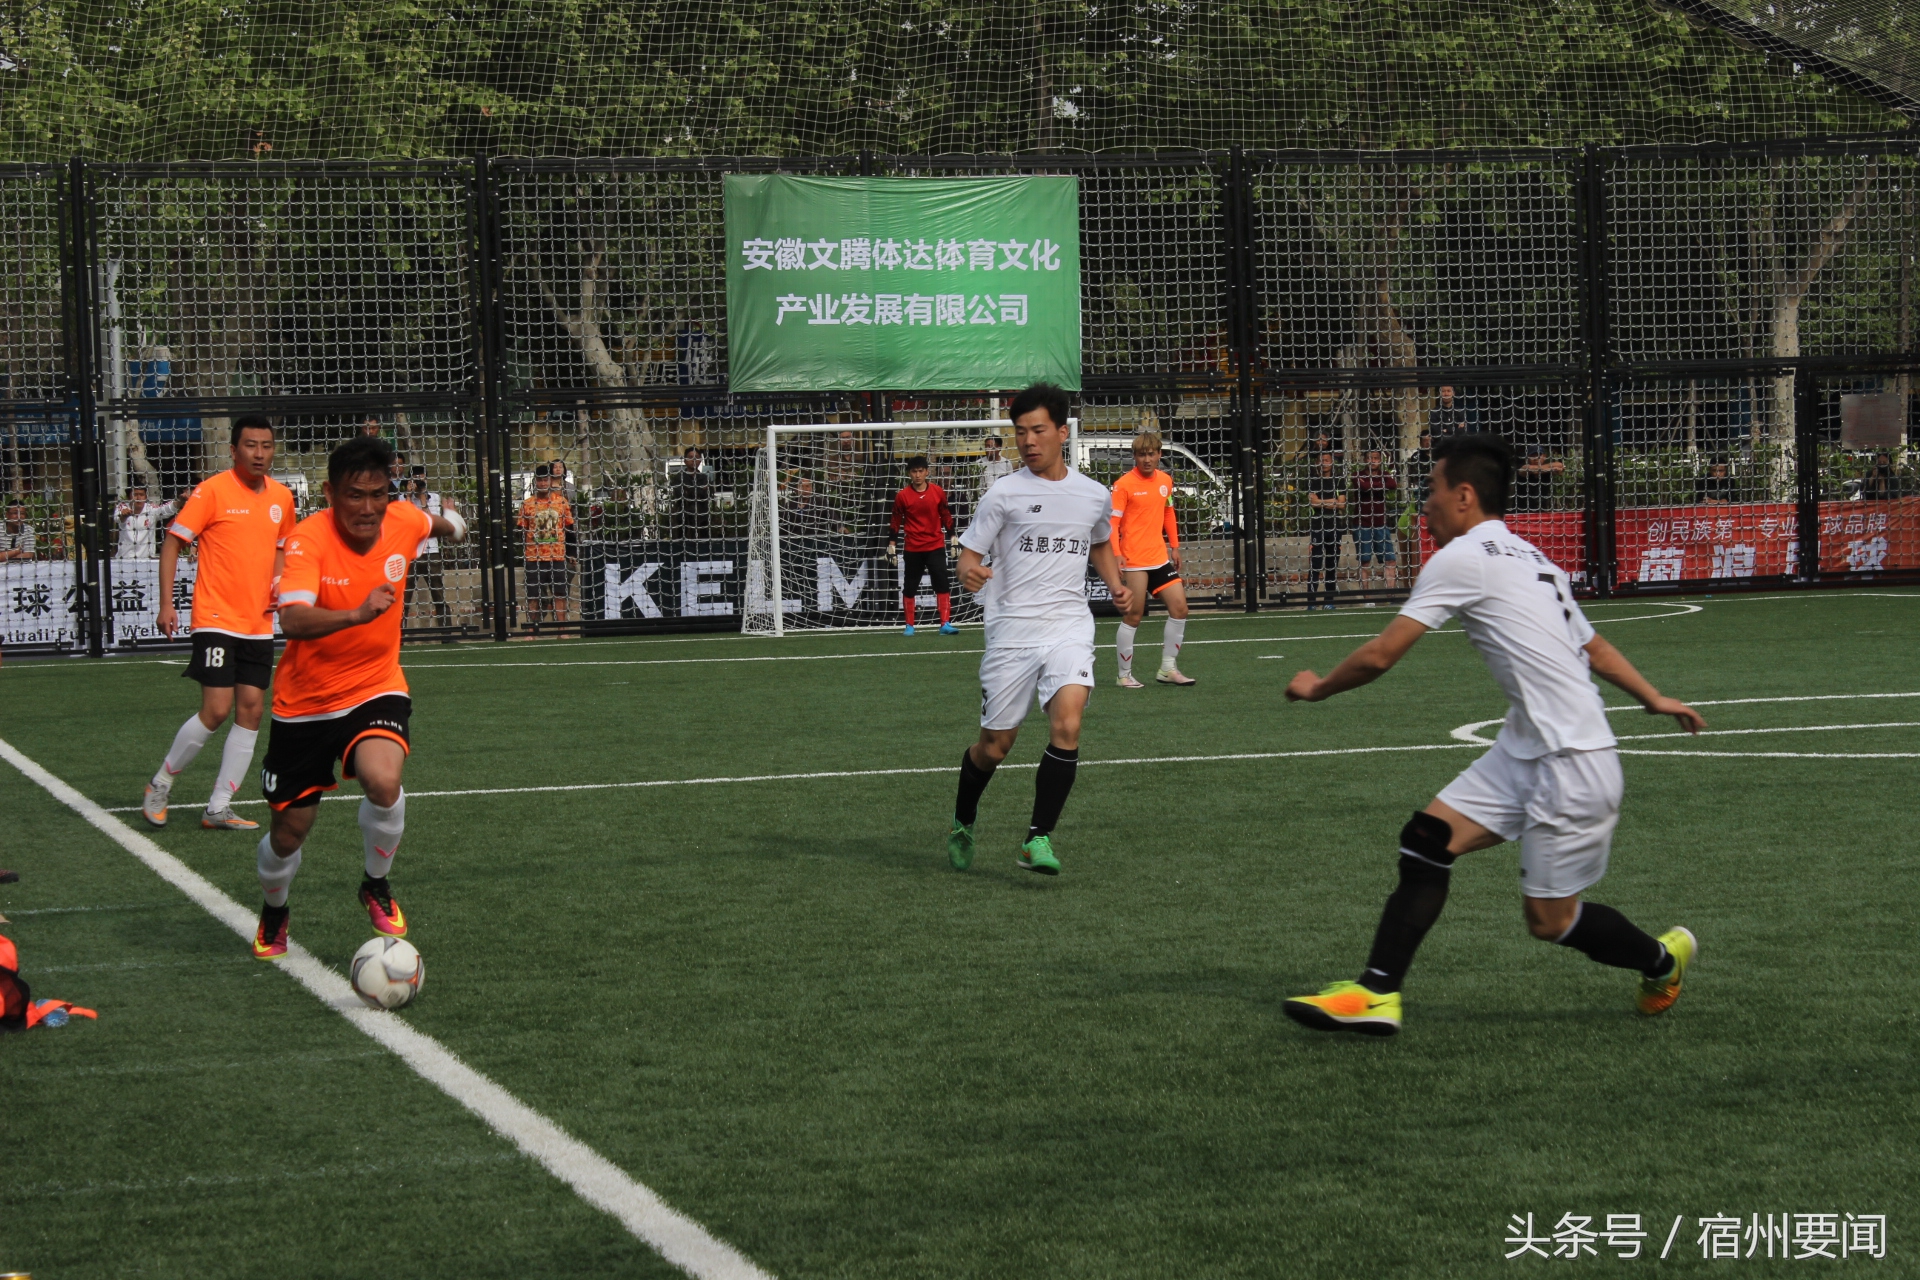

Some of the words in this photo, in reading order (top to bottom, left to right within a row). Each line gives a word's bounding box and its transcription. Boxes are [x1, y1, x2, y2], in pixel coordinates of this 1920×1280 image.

[742, 238, 1060, 271] 安徽文腾体达体育文化
[775, 293, 1028, 326] 产业发展有限公司
[1648, 513, 1887, 542] 创民族第一专业球品牌
[1019, 535, 1089, 557] 法恩莎卫浴
[205, 646, 225, 667] 18
